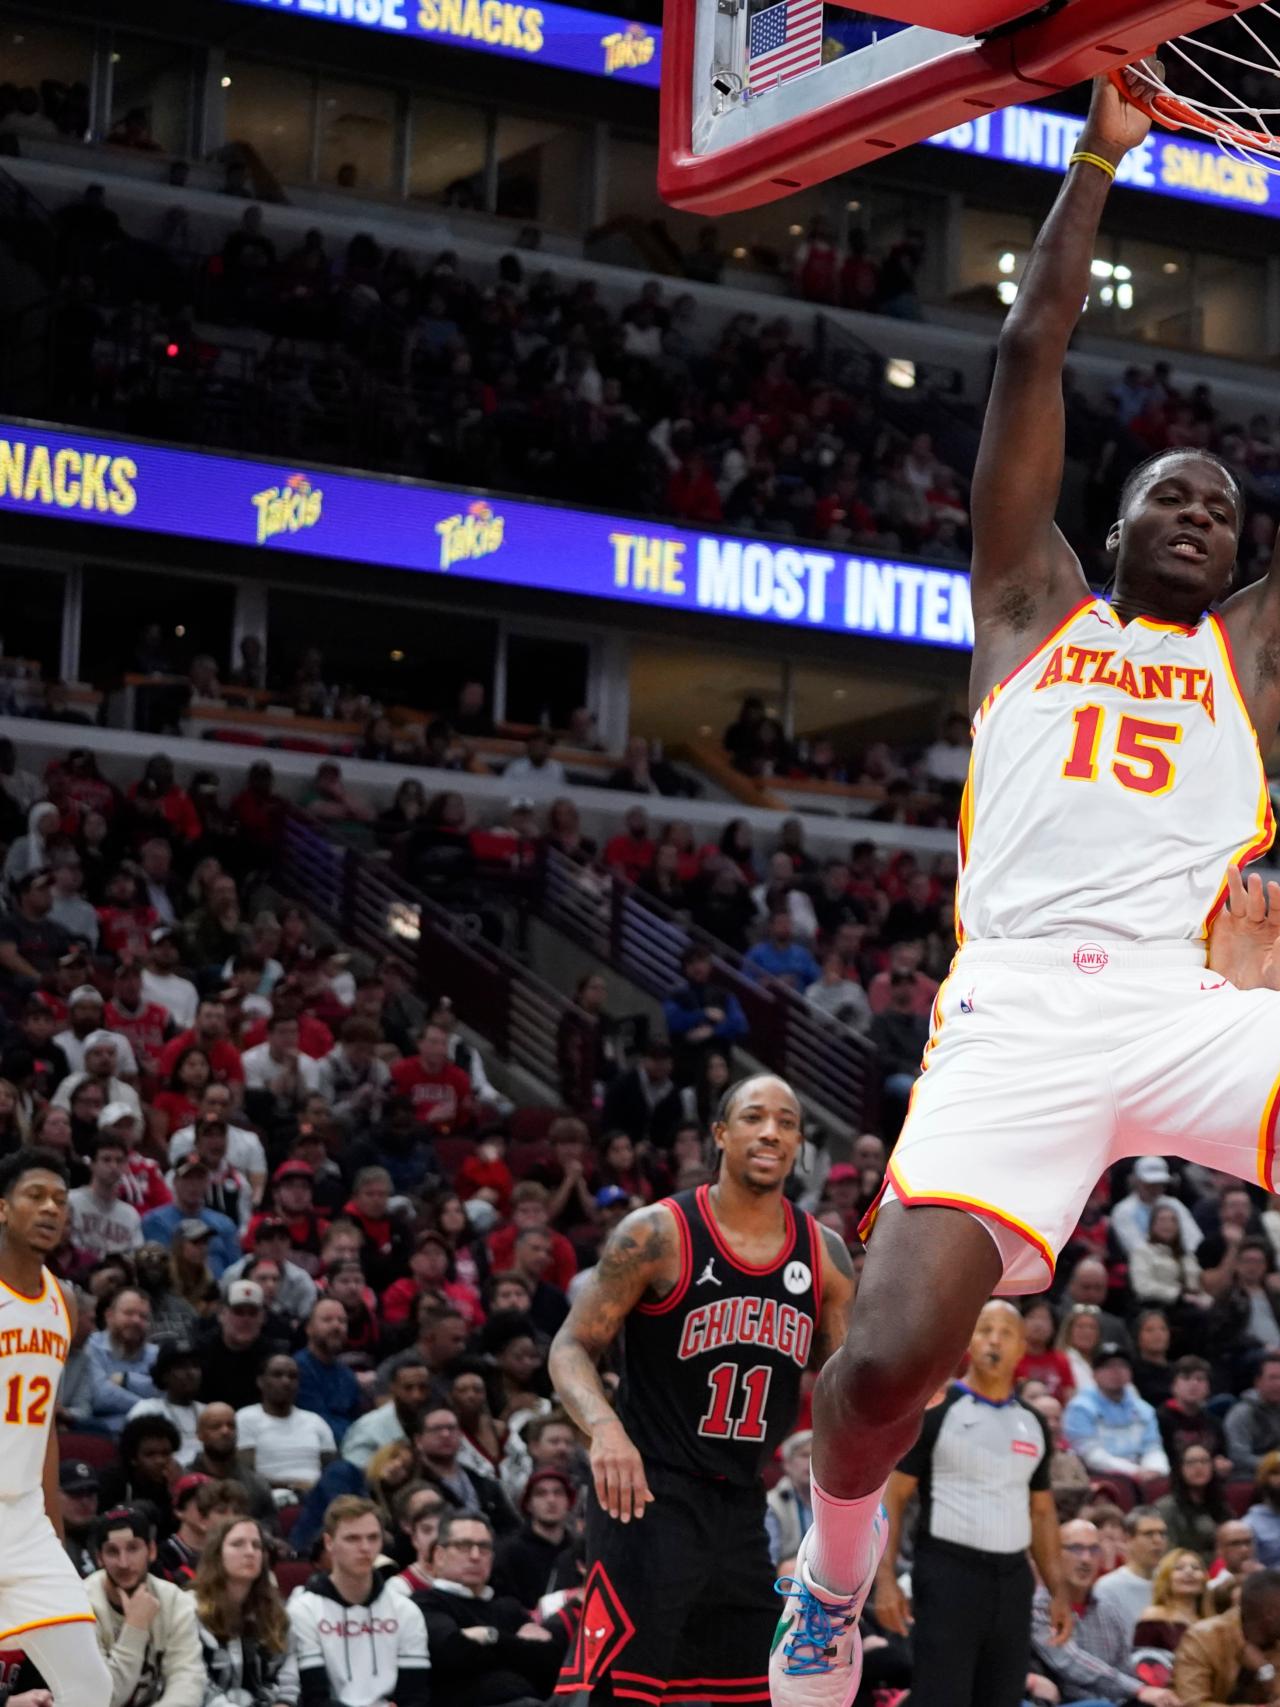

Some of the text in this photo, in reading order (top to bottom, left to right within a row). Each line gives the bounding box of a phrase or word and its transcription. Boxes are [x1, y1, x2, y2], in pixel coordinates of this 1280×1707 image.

[417, 0, 544, 52] SNACKS
[1160, 143, 1270, 206] SNACKS
[251, 480, 323, 545] Takis
[434, 506, 505, 572] Takis
[609, 532, 975, 647] THE MOST INTEN
[1032, 642, 1216, 727] ATLANTA
[1060, 700, 1184, 798] 15
[1072, 952, 1109, 965] HAWKS
[677, 1296, 813, 1368] CHICAGO
[5, 1373, 52, 1425] 12
[697, 1362, 772, 1442] 11
